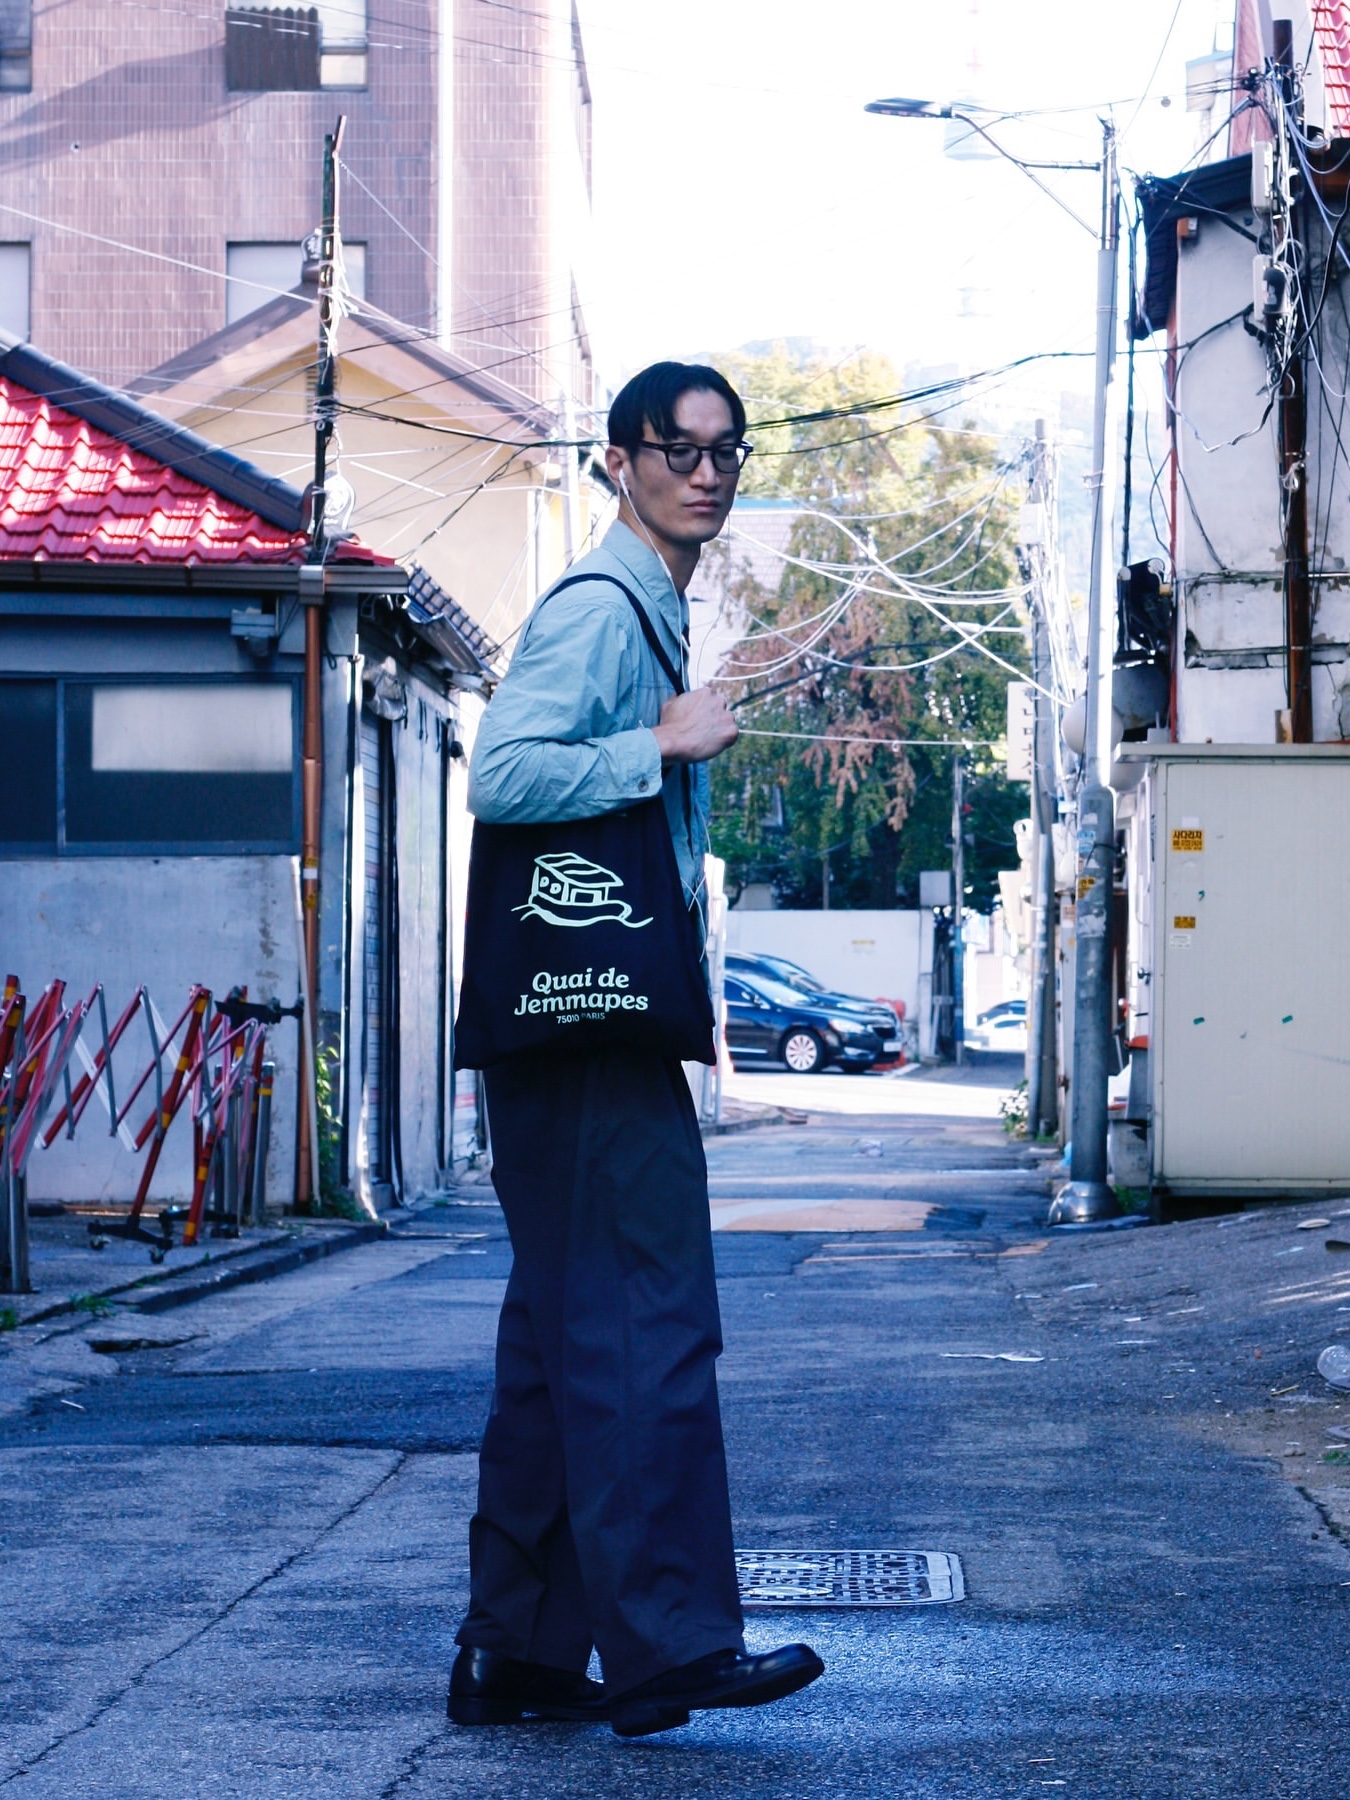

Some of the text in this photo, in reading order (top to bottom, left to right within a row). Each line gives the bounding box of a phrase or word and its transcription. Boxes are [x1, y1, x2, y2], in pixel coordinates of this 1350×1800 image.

[532, 966, 630, 995] Quai de
[514, 992, 649, 1016] Jemmapes
[556, 1012, 606, 1024] 75010 PARIS
